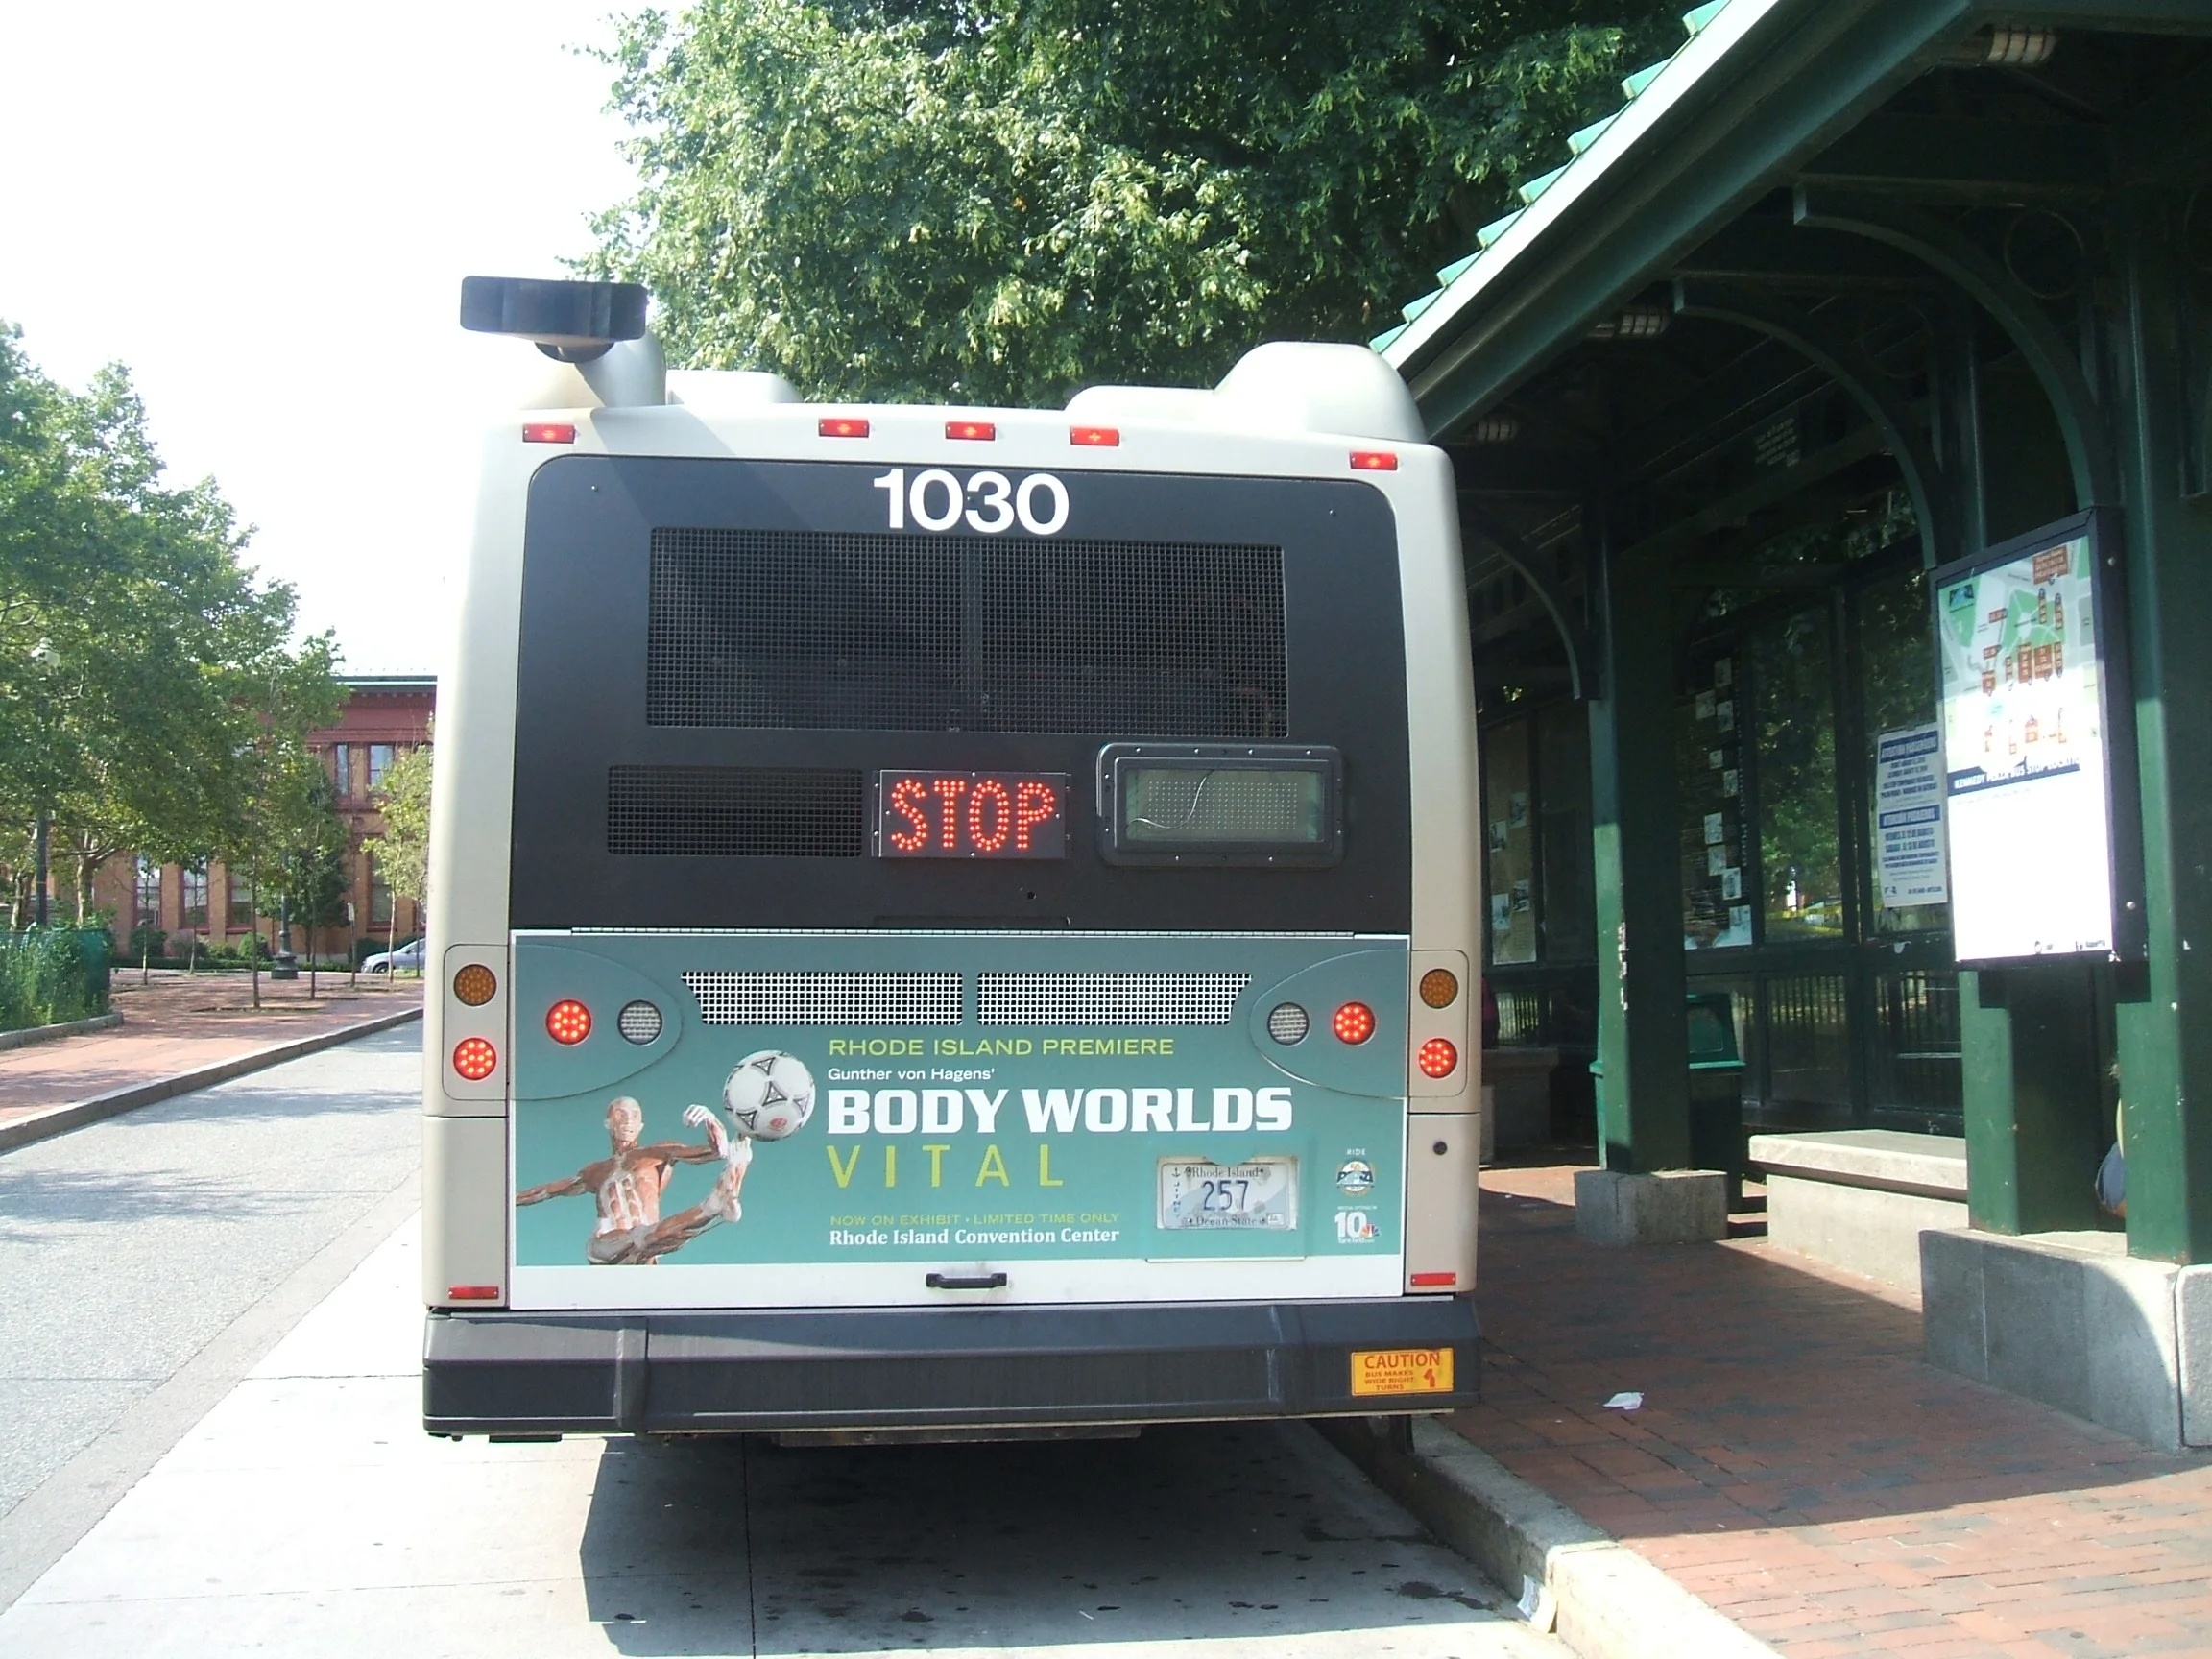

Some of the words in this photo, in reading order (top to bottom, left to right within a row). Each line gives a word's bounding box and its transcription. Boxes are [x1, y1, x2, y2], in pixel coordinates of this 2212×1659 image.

[874, 468, 1070, 536] 1030
[891, 779, 1056, 852] STOP
[830, 1039, 924, 1056] RHODE
[934, 1039, 1033, 1056] ISLAND
[1043, 1039, 1174, 1055] PREMIERE
[828, 1068, 892, 1080] Gunther
[898, 1070, 926, 1080] von
[931, 1068, 995, 1082] Hagens'
[828, 1089, 1009, 1134] BODY
[1022, 1087, 1292, 1133] WORLDS
[827, 1144, 1064, 1188] VITAL
[1192, 1166, 1223, 1178] Rhode
[1227, 1166, 1259, 1178] Island
[1202, 1180, 1249, 1211] 257
[830, 1215, 865, 1226] NOW
[871, 1215, 894, 1225] ON
[900, 1214, 960, 1225] EXHIBIT
[974, 1214, 1034, 1224] LIMITED
[1040, 1214, 1074, 1223] TIME
[1080, 1213, 1119, 1223] ONLY
[1196, 1216, 1229, 1227] Ocean
[1232, 1216, 1258, 1227] State
[1334, 1211, 1367, 1238] 10
[830, 1230, 888, 1245] Rhode
[894, 1229, 949, 1244] Island
[954, 1228, 1055, 1244] Convention
[1061, 1228, 1119, 1242] Center
[1364, 1353, 1440, 1369] CAUTION
